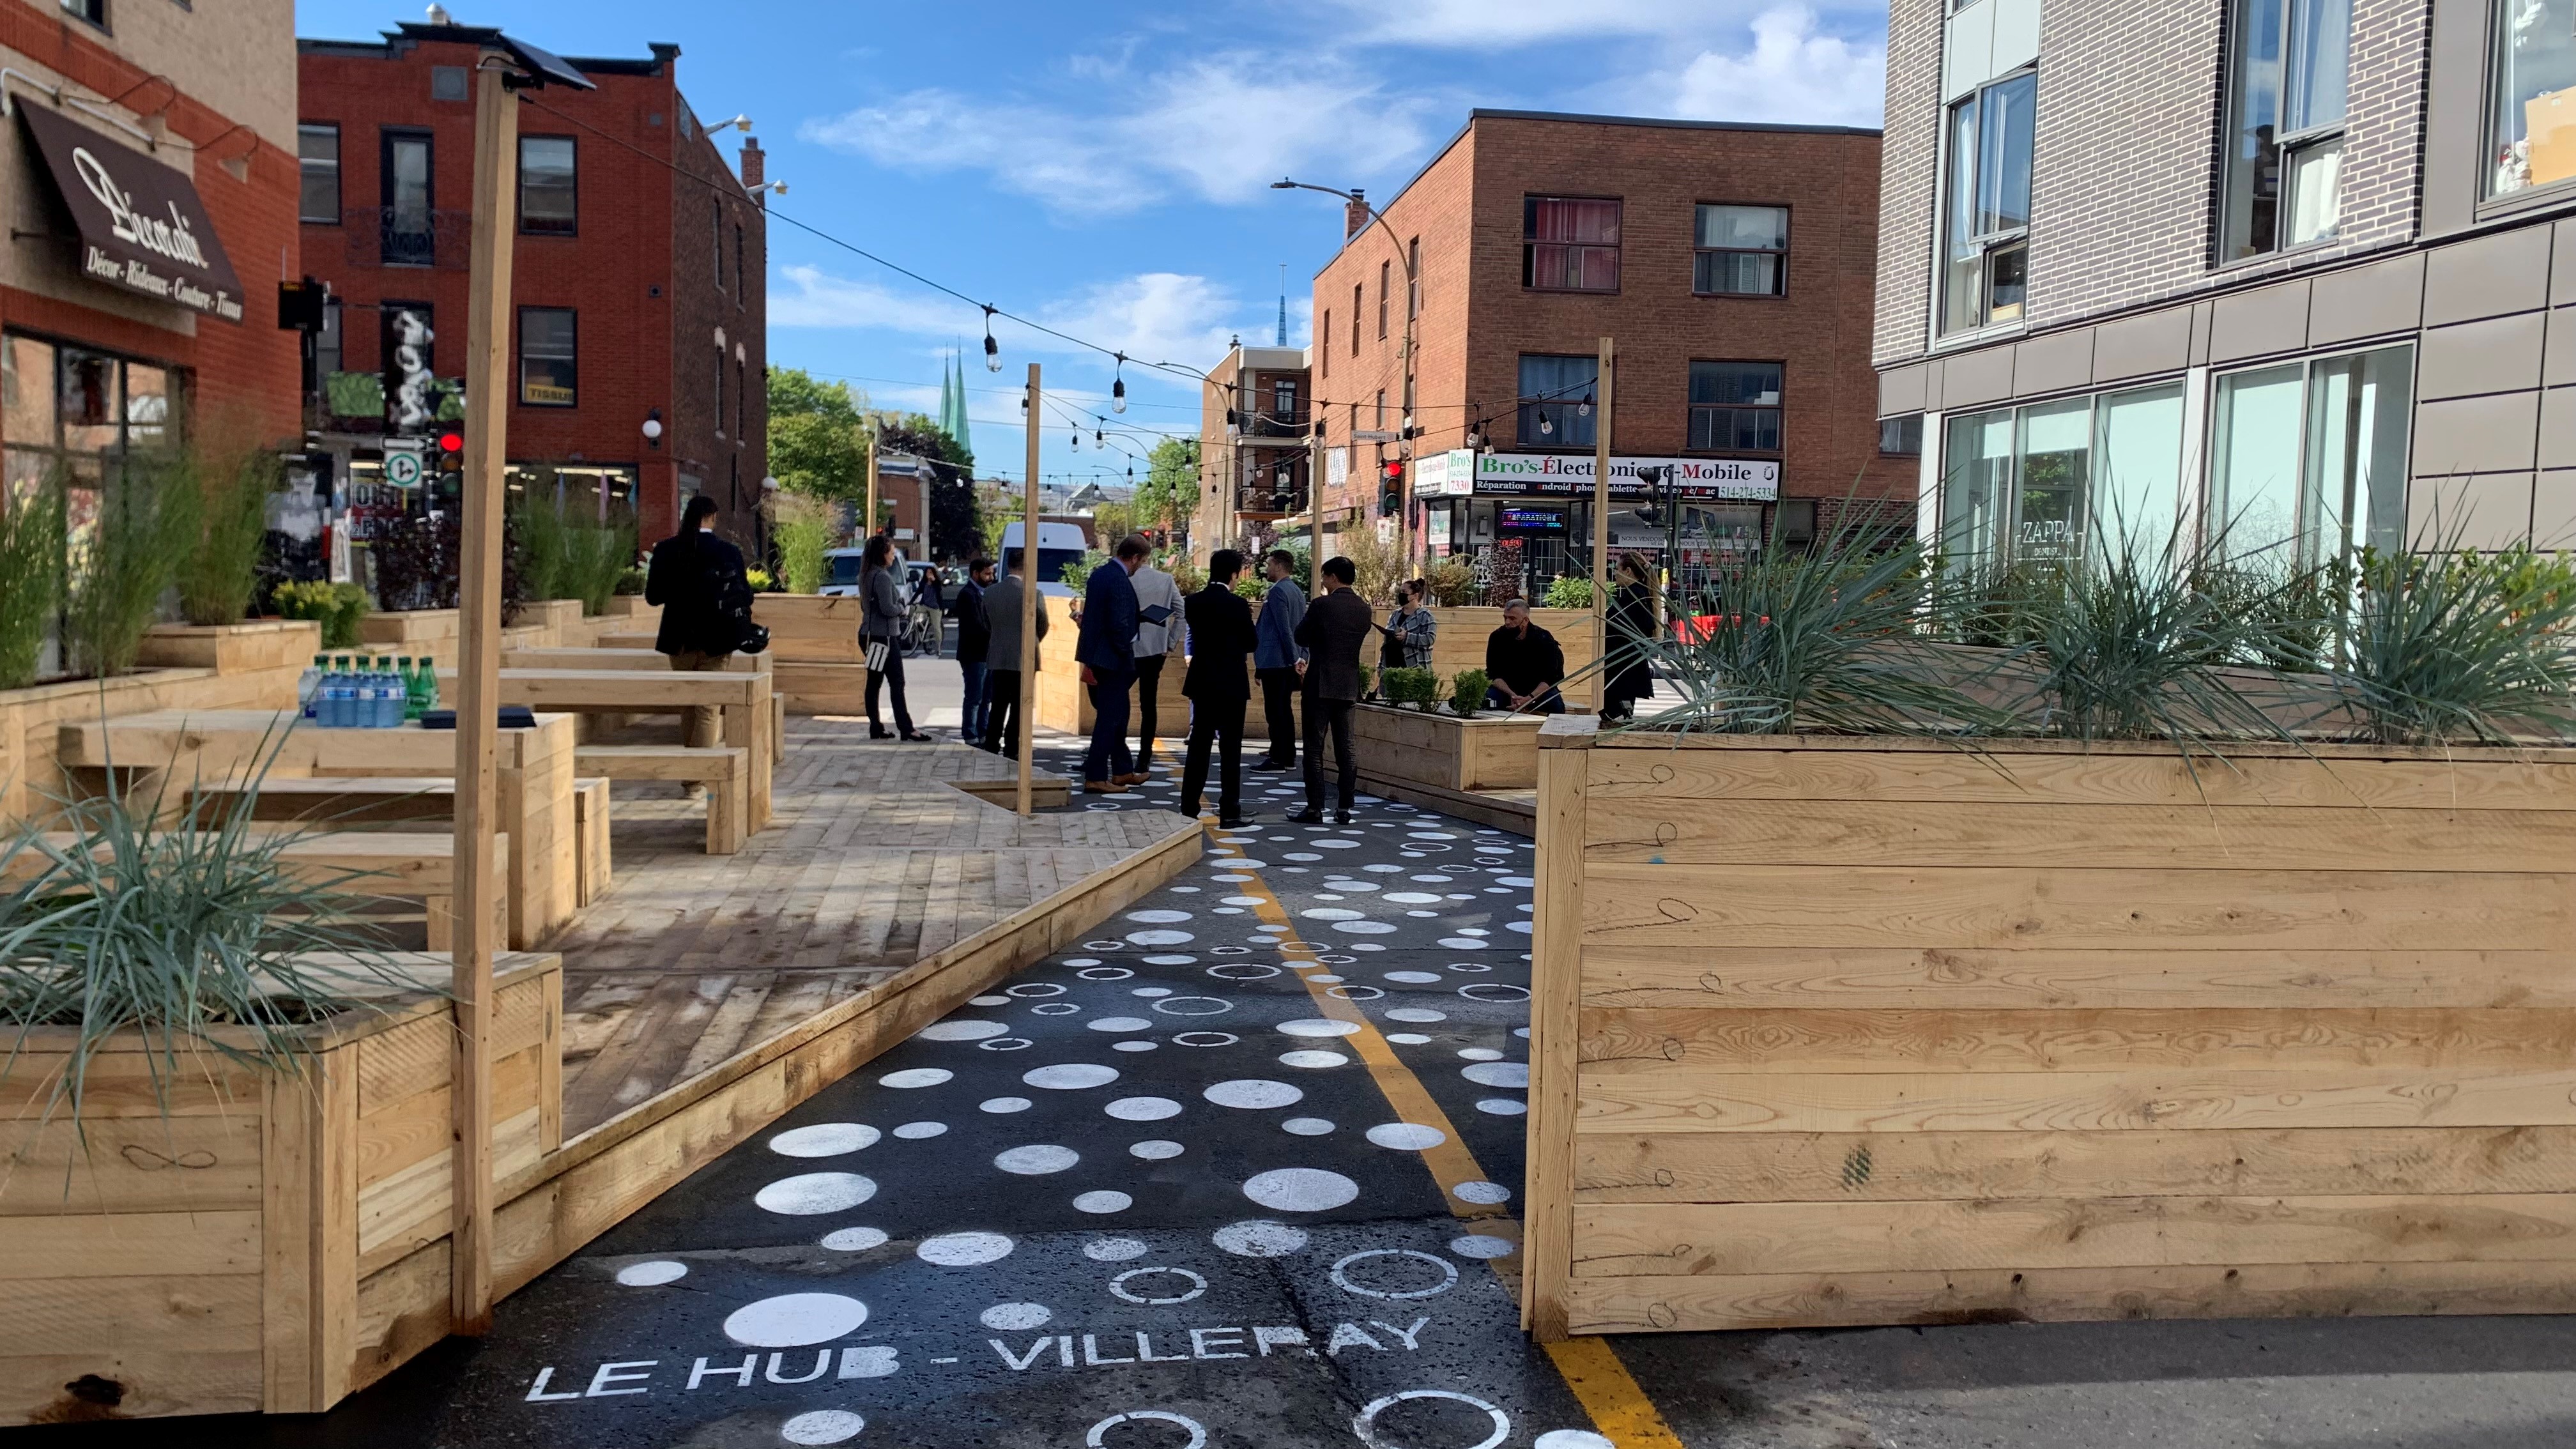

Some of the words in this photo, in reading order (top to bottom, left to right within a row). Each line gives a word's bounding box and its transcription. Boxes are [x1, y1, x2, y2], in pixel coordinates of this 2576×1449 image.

[87, 246, 121, 279] Décor
[126, 259, 169, 296] Rideaux
[174, 277, 211, 311] Couture
[216, 291, 242, 320] Tissus
[1450, 452, 1471, 467] Bro's
[1451, 480, 1469, 491] 7330
[1476, 481, 1526, 491] Réparation
[1607, 484, 1637, 493] ablette
[1659, 486, 1682, 494] vieo
[1721, 486, 1776, 500] 514-274-5334
[2023, 521, 2074, 543] ZAPPA
[525, 1360, 659, 1402] LE
[686, 1346, 901, 1390] HUB
[988, 1317, 1430, 1370] VILLERAY
